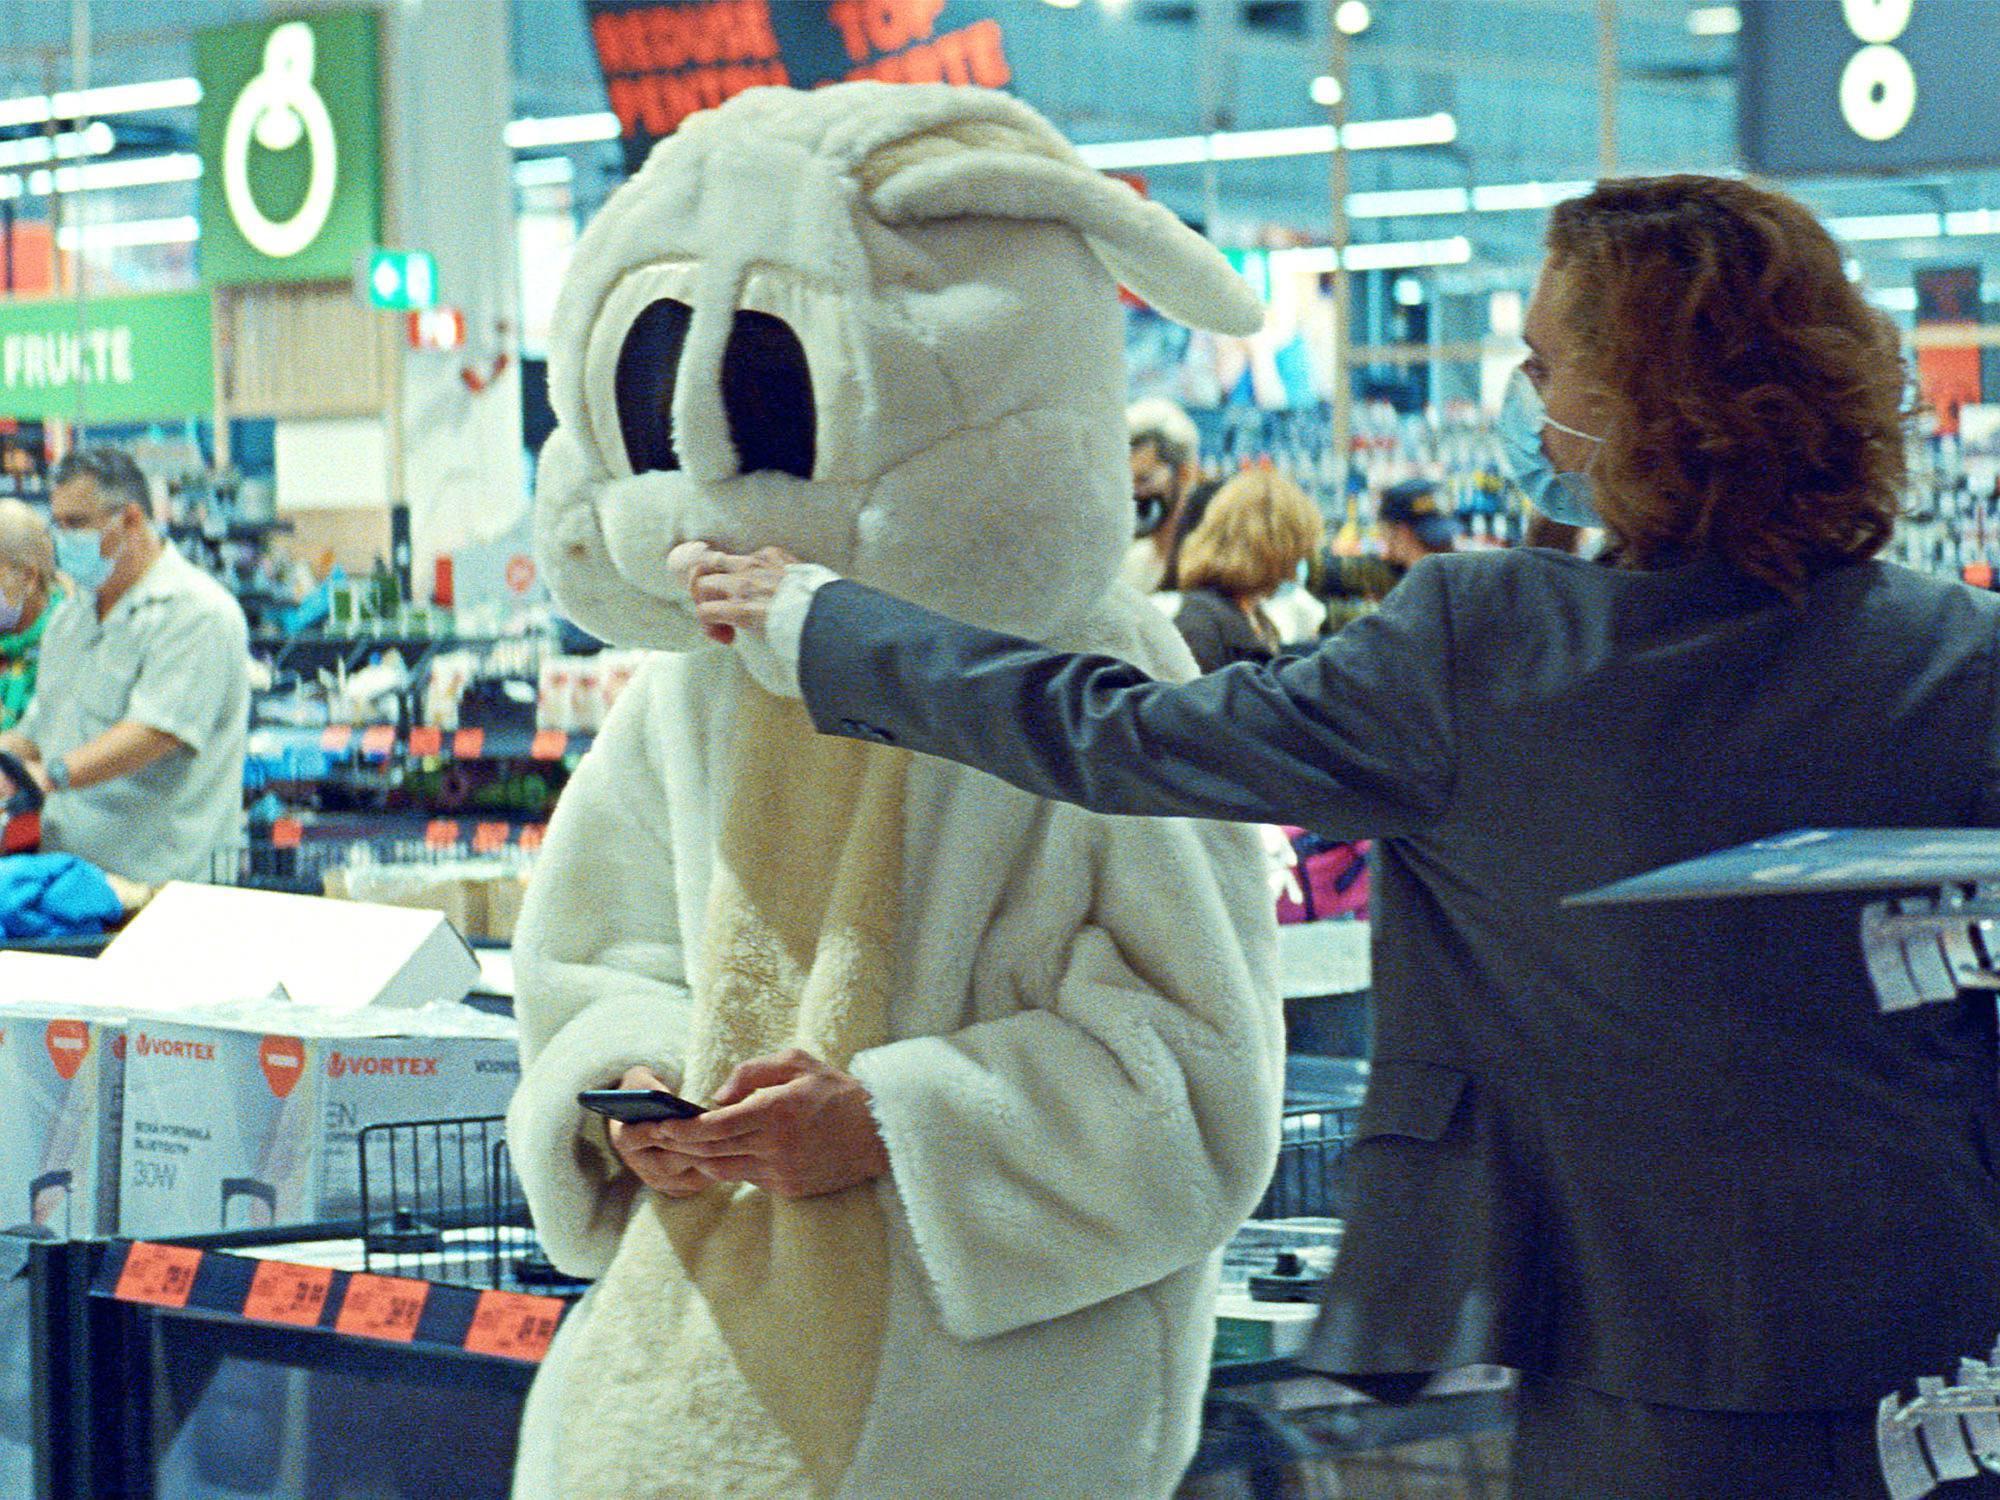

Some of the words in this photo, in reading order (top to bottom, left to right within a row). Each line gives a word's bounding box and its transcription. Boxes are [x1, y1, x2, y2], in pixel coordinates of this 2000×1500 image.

[3, 326, 133, 389] FRUCTE
[151, 1038, 216, 1061] VORTEX
[348, 1055, 438, 1077] VORTEX
